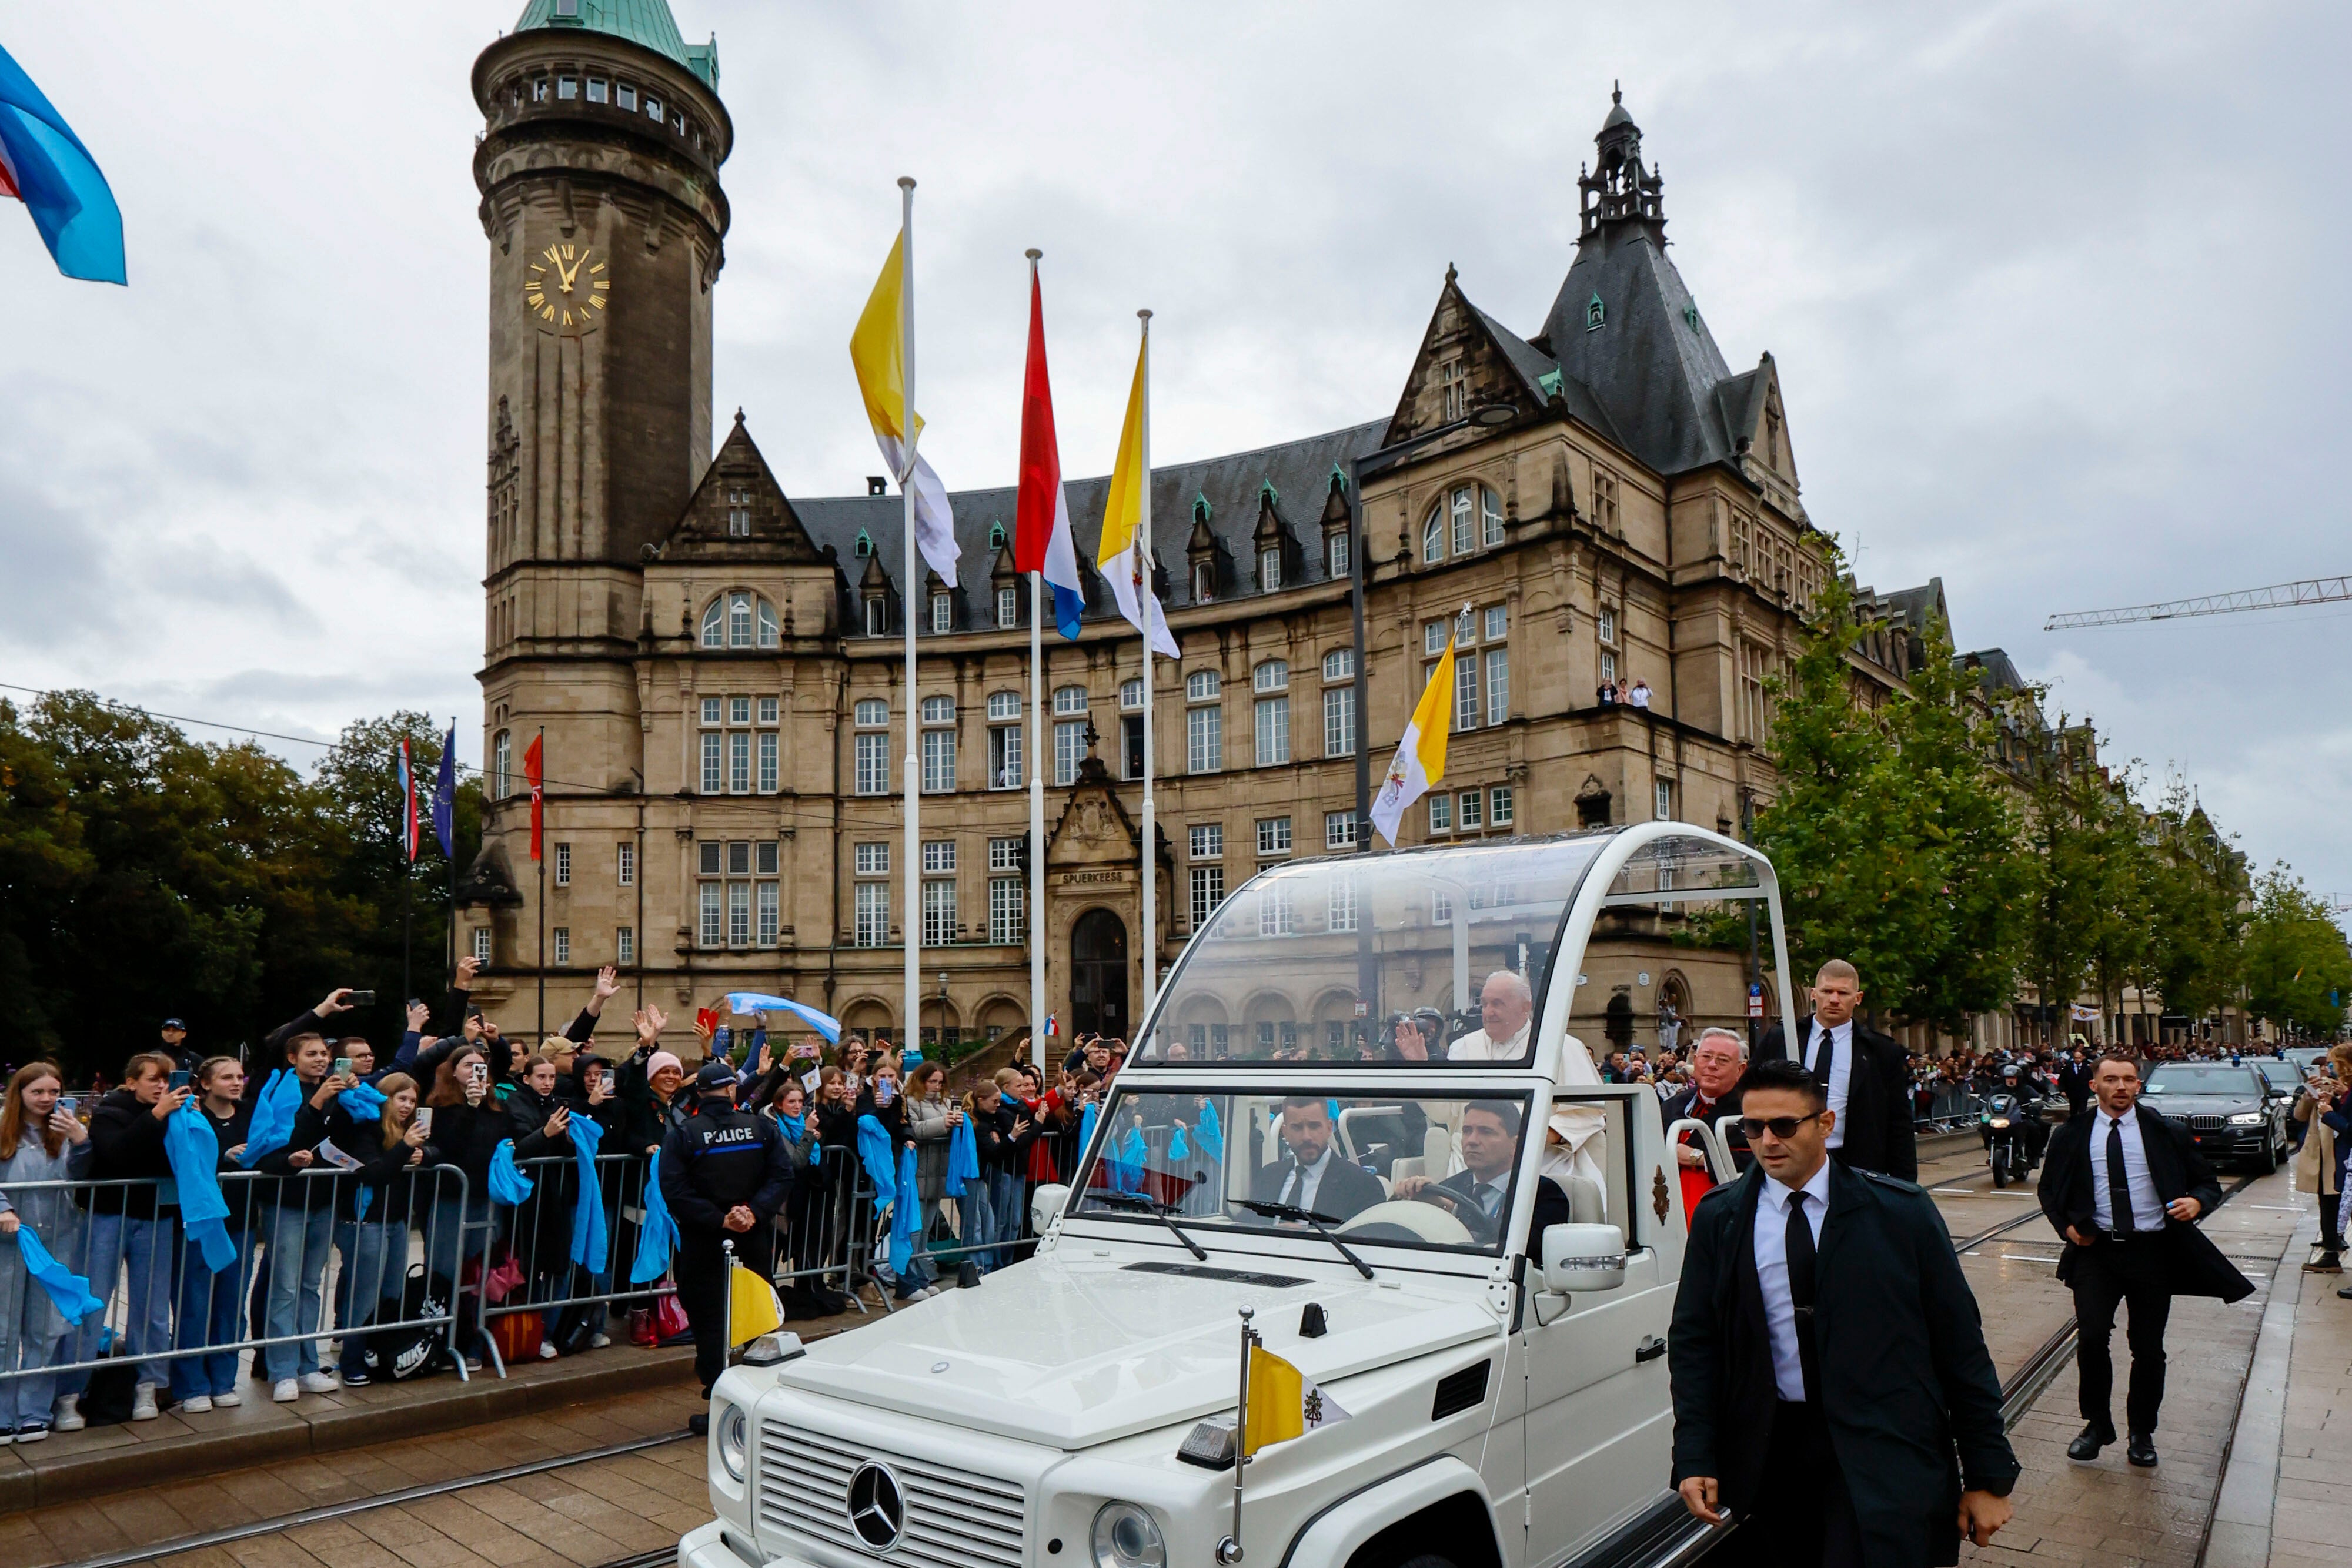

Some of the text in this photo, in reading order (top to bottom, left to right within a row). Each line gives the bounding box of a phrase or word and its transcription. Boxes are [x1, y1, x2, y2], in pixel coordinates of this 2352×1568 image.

[1063, 871, 1122, 885] SPUERKEESS
[703, 1127, 754, 1144] POLICE
[396, 1339, 425, 1369] NIKE
